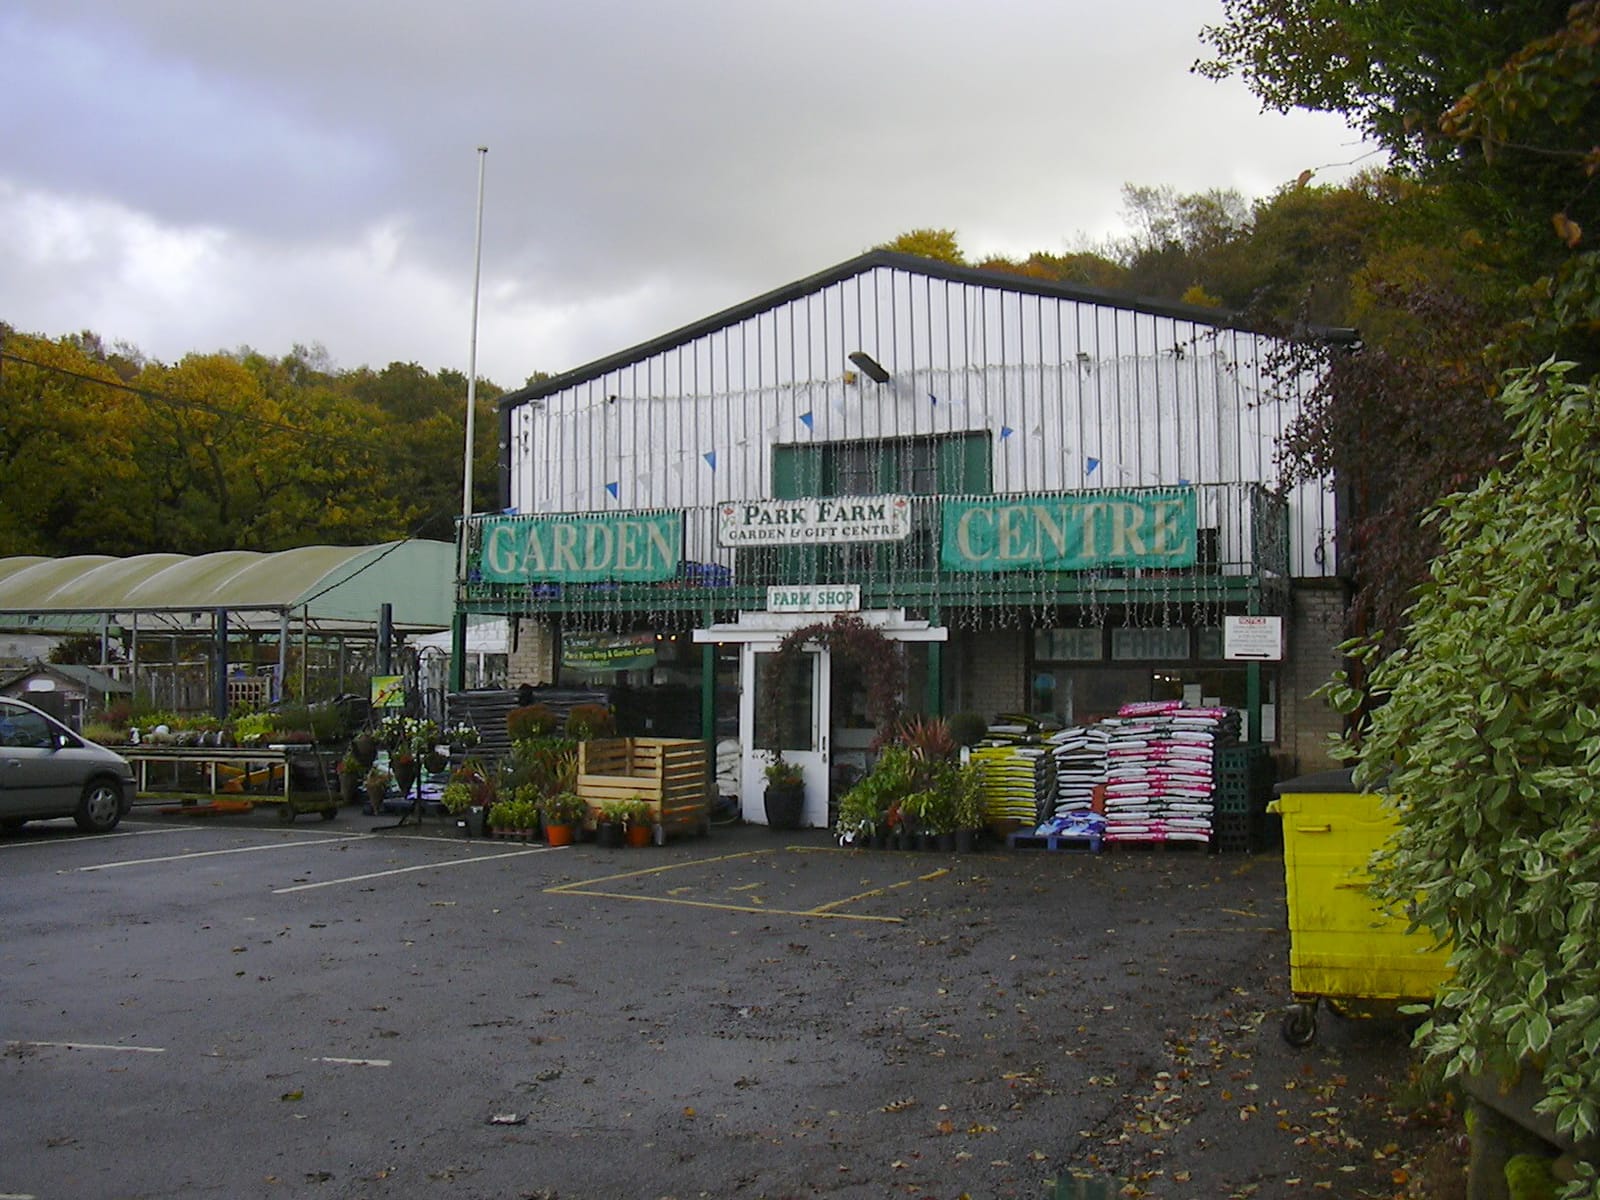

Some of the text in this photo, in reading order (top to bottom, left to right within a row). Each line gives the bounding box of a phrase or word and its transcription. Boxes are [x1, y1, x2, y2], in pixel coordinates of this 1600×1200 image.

[742, 501, 885, 525] PARK FARM
[729, 524, 900, 540] GARDEN & GIFT CENTRE
[957, 500, 1188, 561] CENTRE
[487, 519, 680, 574] GARDEN
[773, 591, 854, 606] FARM SHOP
[1239, 617, 1266, 625] NOTICE
